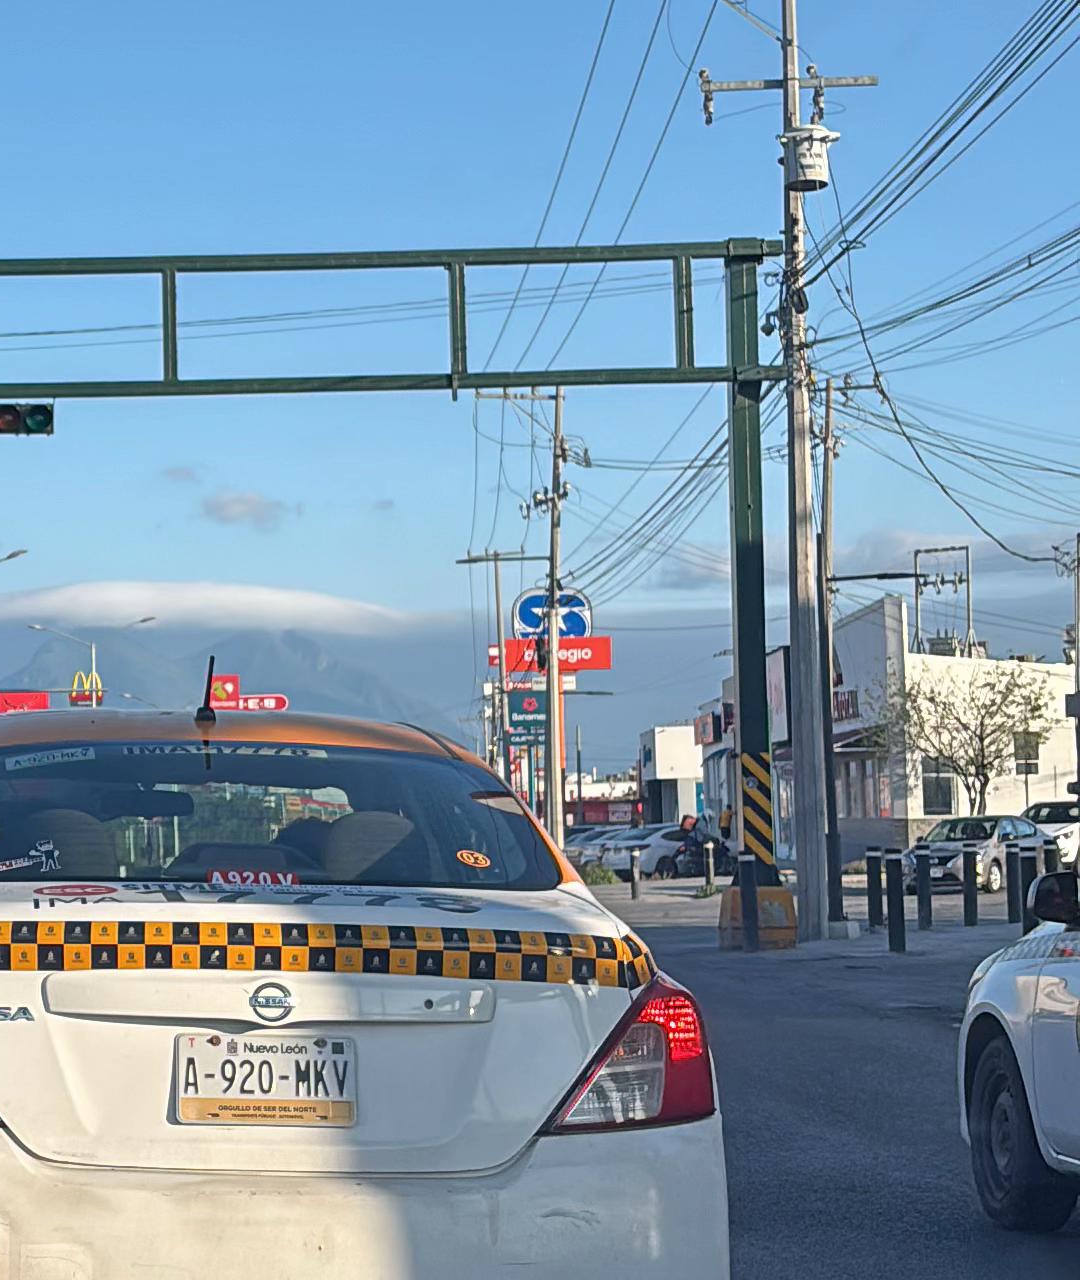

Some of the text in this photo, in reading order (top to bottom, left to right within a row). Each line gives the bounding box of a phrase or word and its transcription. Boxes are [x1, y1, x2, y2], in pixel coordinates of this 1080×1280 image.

[243, 1041, 307, 1055] Nuevo León
[183, 1057, 348, 1097] A-920-MKV
